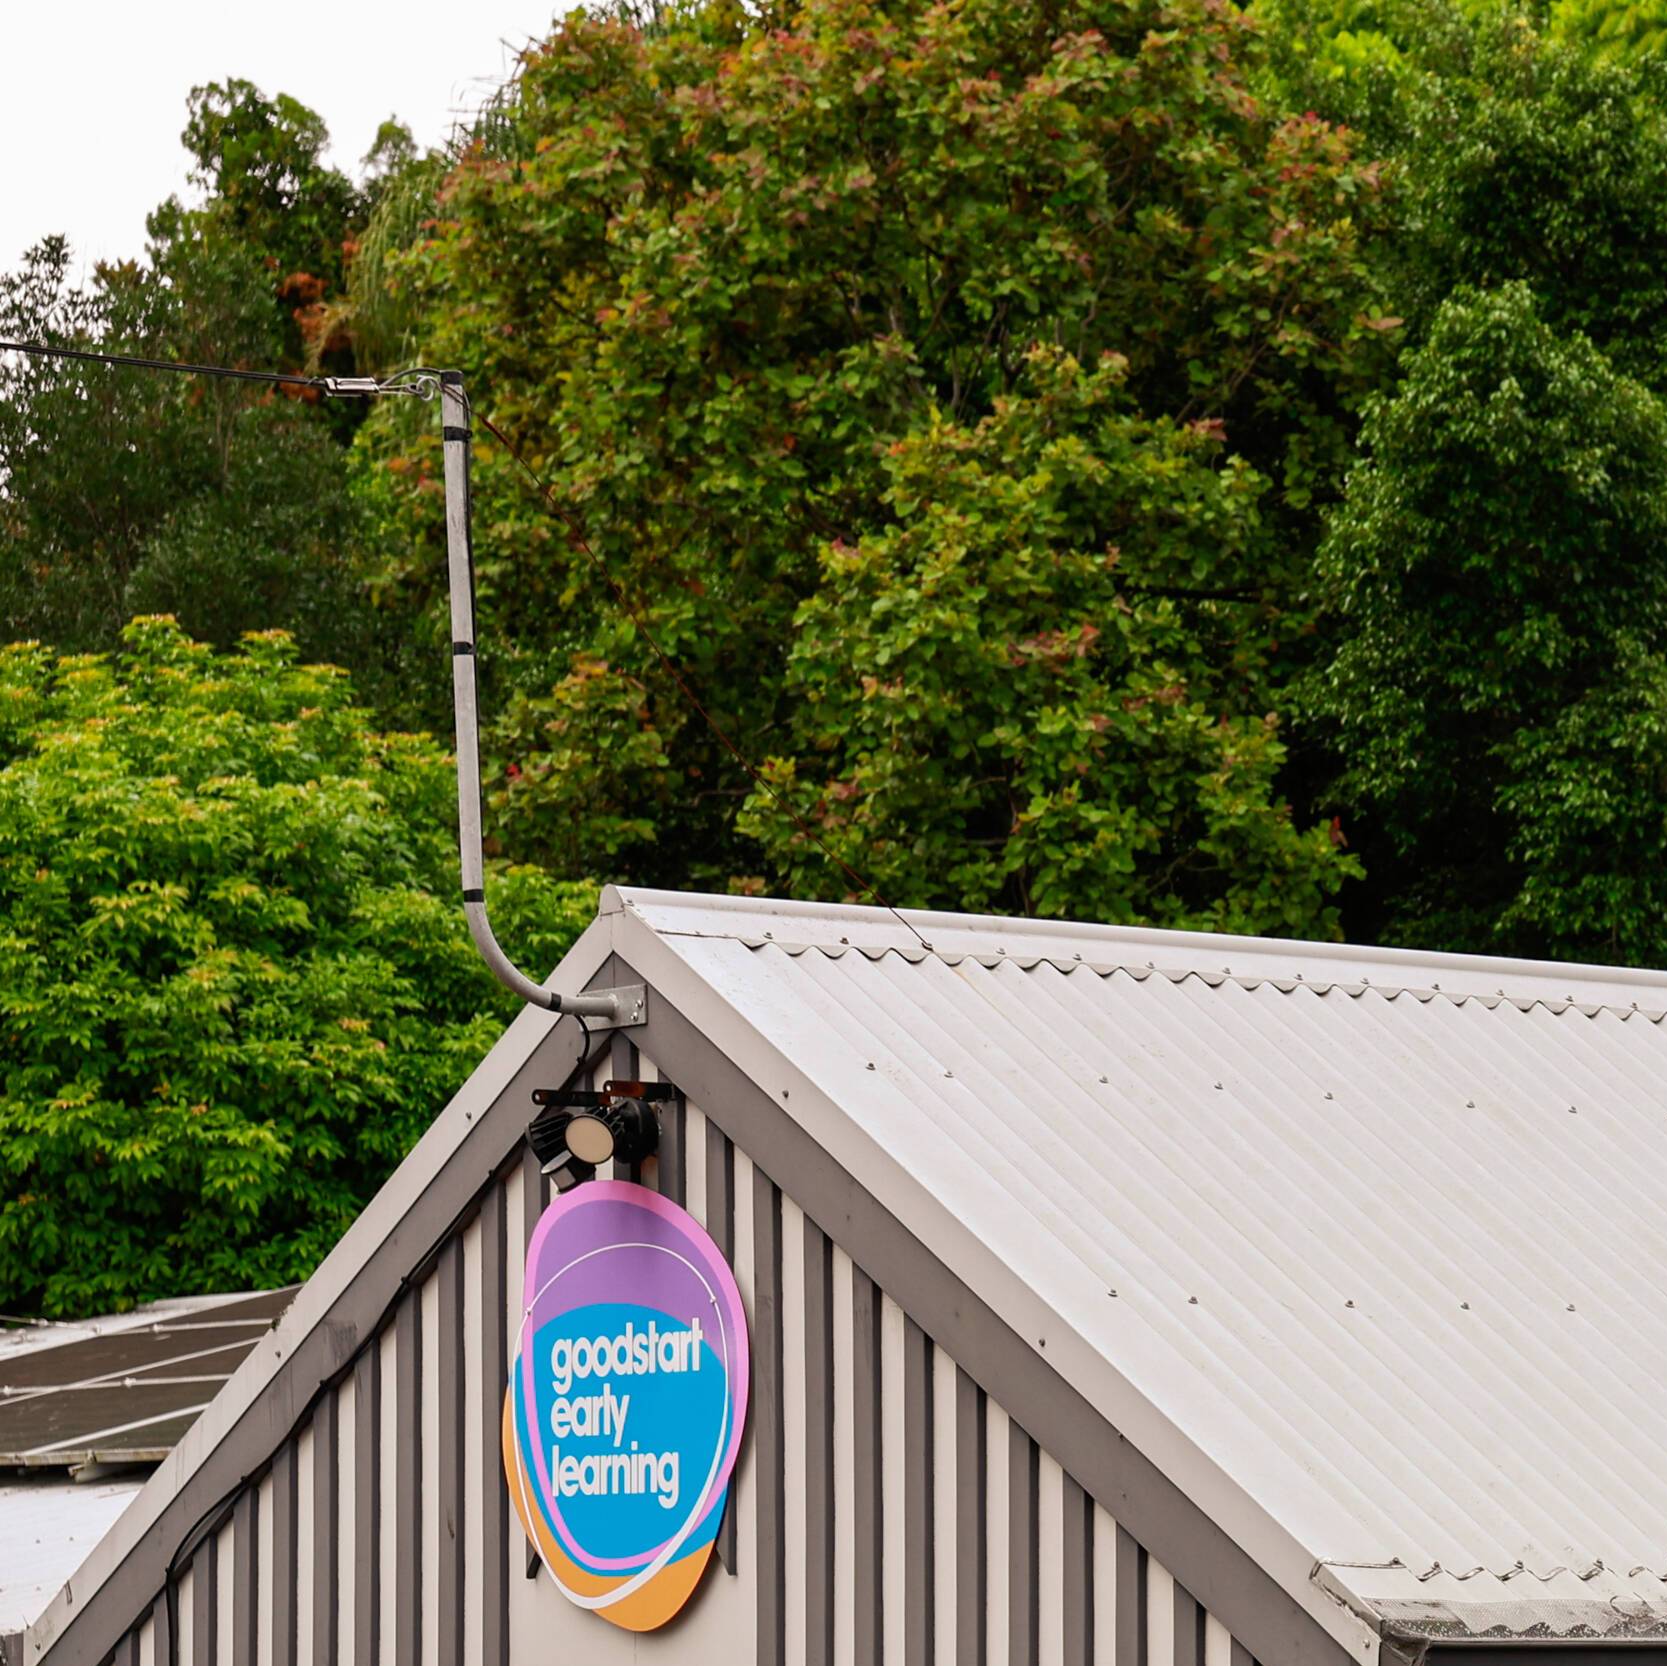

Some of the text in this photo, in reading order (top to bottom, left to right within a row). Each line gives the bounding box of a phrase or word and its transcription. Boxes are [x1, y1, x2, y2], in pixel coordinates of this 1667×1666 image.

[551, 1317, 703, 1395] goodstart
[551, 1383, 630, 1447] early
[552, 1441, 679, 1509] learning
